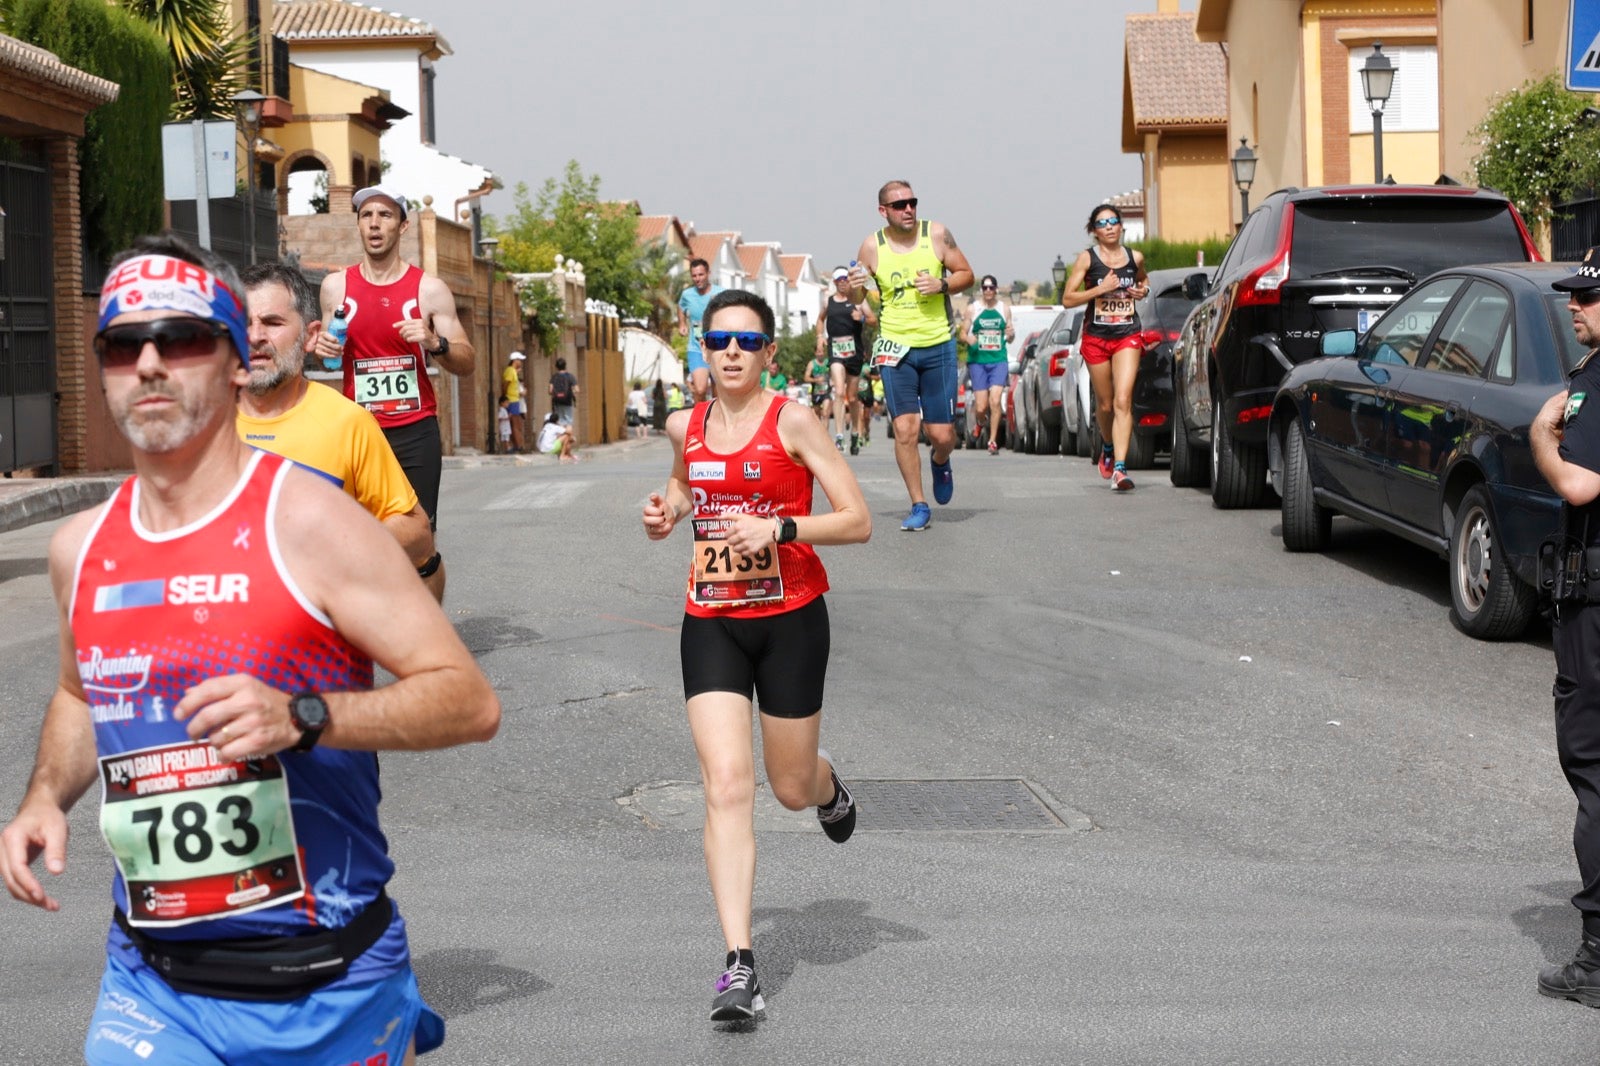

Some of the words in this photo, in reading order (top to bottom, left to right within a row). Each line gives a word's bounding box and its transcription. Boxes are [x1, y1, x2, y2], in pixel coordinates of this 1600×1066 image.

[367, 374, 408, 397] 316
[168, 574, 249, 605] SEUR
[133, 754, 163, 778] GRAN
[163, 747, 207, 772] PREMIO
[131, 795, 261, 865] 783
